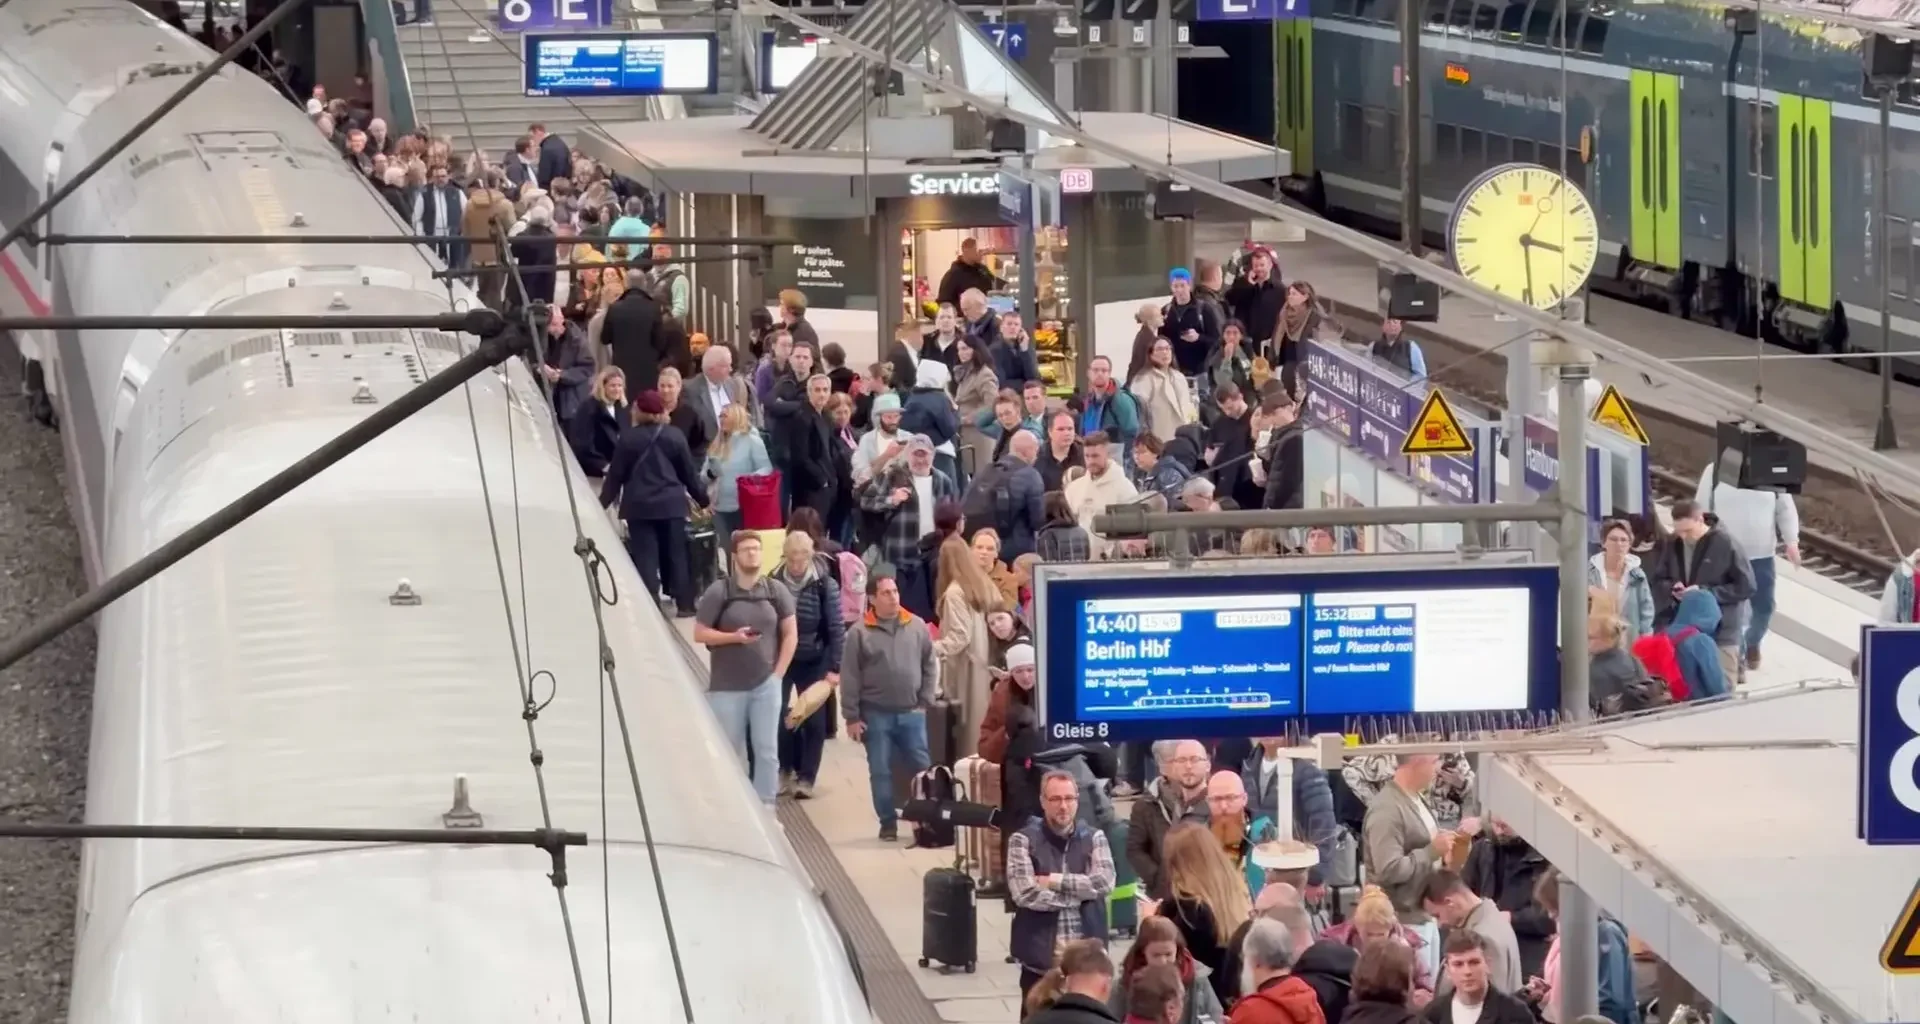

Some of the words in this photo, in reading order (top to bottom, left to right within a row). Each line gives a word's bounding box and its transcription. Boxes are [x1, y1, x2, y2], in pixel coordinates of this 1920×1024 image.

[992, 29, 1005, 48] 7
[1066, 174, 1087, 188] DB
[1315, 608, 1348, 621] 15:32
[1086, 614, 1137, 634] 14:40
[1313, 628, 1332, 641] gen
[1338, 624, 1364, 637] Bitte
[1365, 624, 1391, 637] nicht
[1086, 640, 1137, 661] Berlin
[1140, 637, 1172, 659] Hbf
[1345, 640, 1380, 653] Please
[1381, 640, 1396, 652] do
[1053, 722, 1095, 739] Gleis
[1098, 721, 1109, 738] 8
